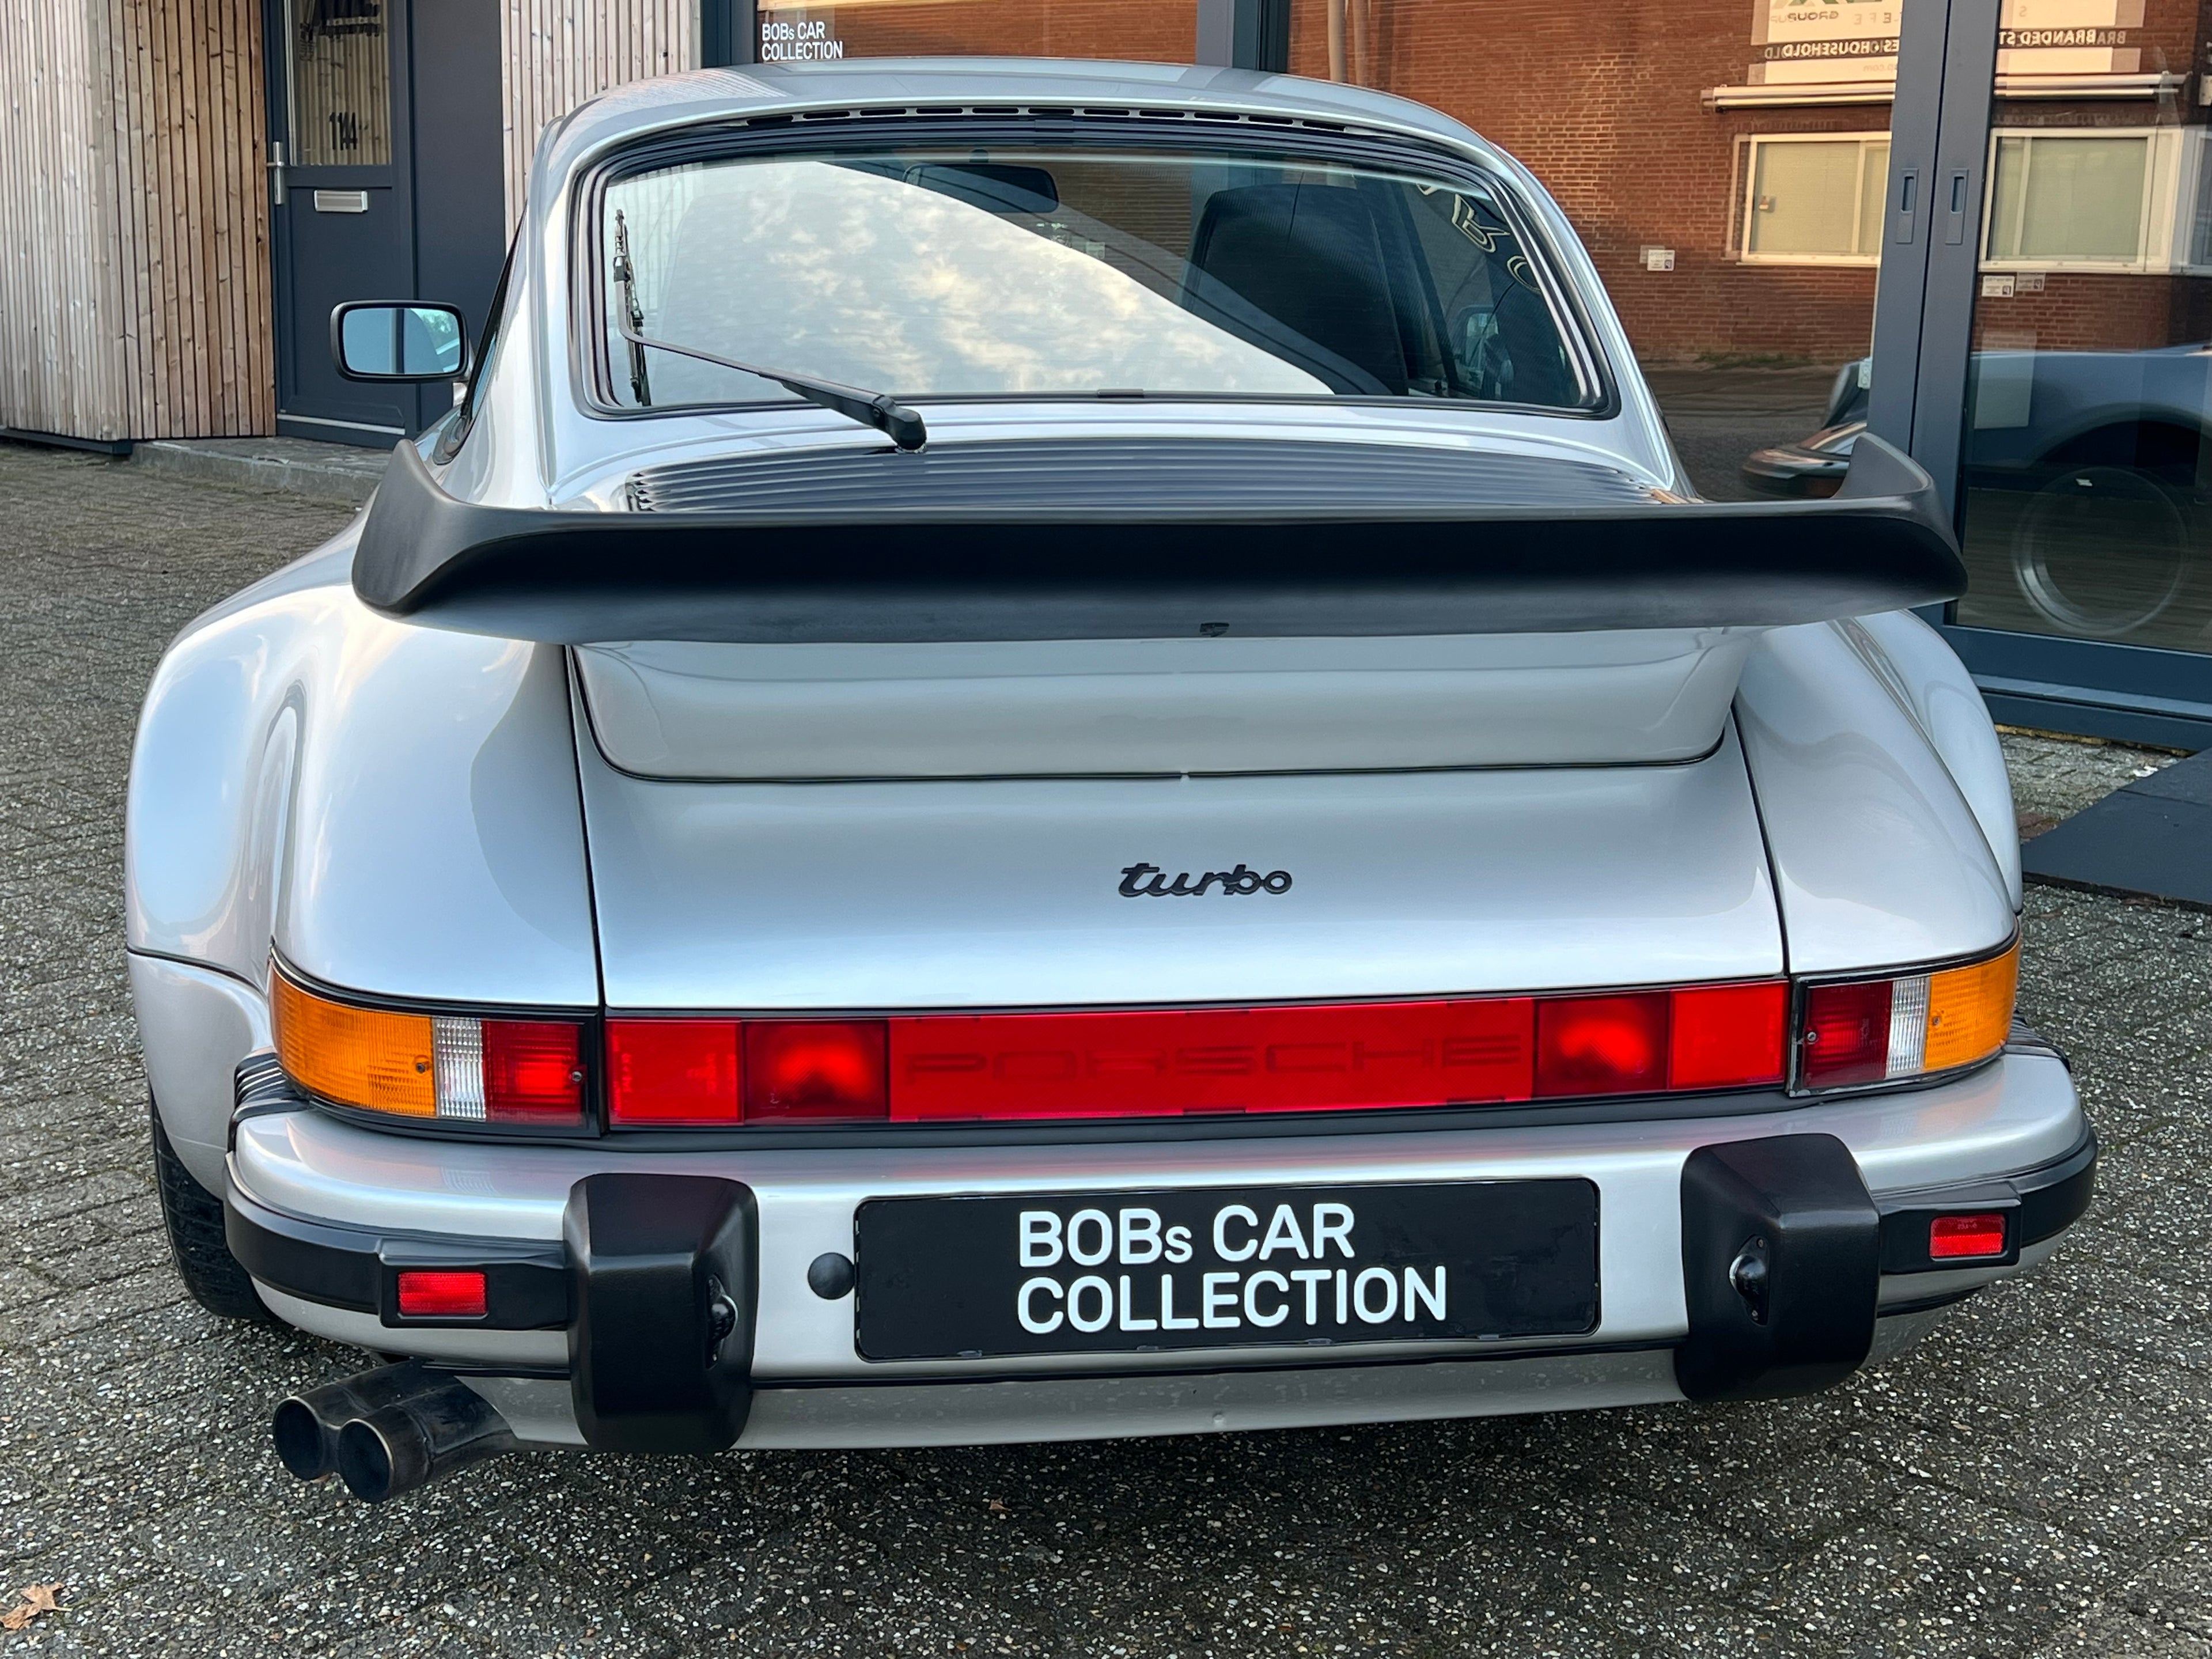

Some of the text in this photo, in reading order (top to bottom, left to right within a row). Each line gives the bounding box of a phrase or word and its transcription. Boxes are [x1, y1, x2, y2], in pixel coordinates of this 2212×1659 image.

[762, 21, 825, 41] BOBs CAR
[762, 40, 843, 61] COLLECTION
[1118, 862, 1293, 897] turbo
[903, 1033, 1522, 1086] PORSCHE
[1019, 1202, 1355, 1268] BOBs CAR
[1017, 1265, 1447, 1334] COLLECTION
